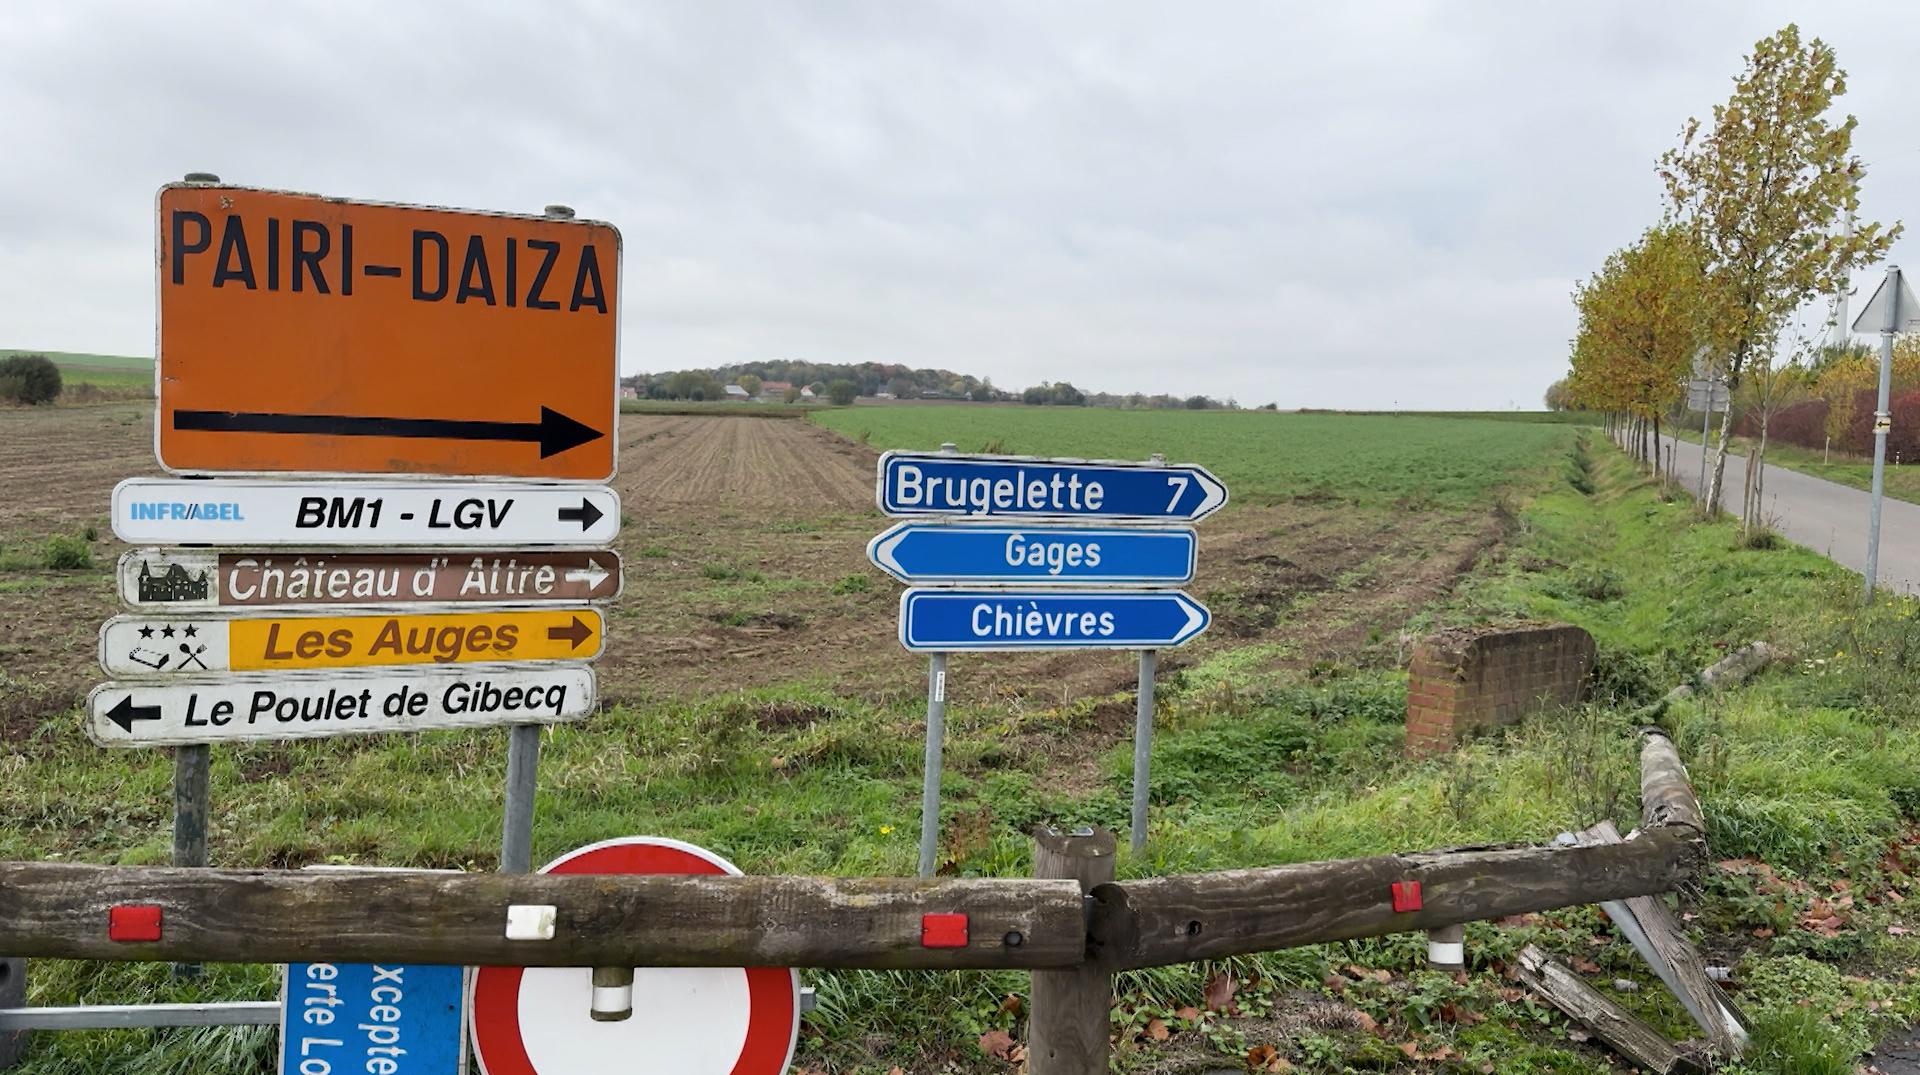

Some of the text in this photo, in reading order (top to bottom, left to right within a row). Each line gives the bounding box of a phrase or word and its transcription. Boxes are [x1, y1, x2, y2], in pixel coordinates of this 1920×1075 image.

[172, 210, 608, 314] PAIRI-DAIZA
[130, 503, 244, 521] INFRABEL
[896, 465, 1189, 515] Brugelette 7
[295, 497, 383, 529] BM1
[428, 499, 514, 530] LGV
[1005, 533, 1101, 575] Gages
[228, 556, 399, 600] Château
[971, 601, 1116, 637] Chièvres
[264, 620, 519, 663] Les Auges
[184, 680, 567, 727] Le Poulet de Gibecq
[303, 962, 345, 1025] erte
[358, 964, 408, 1075] xcepte
